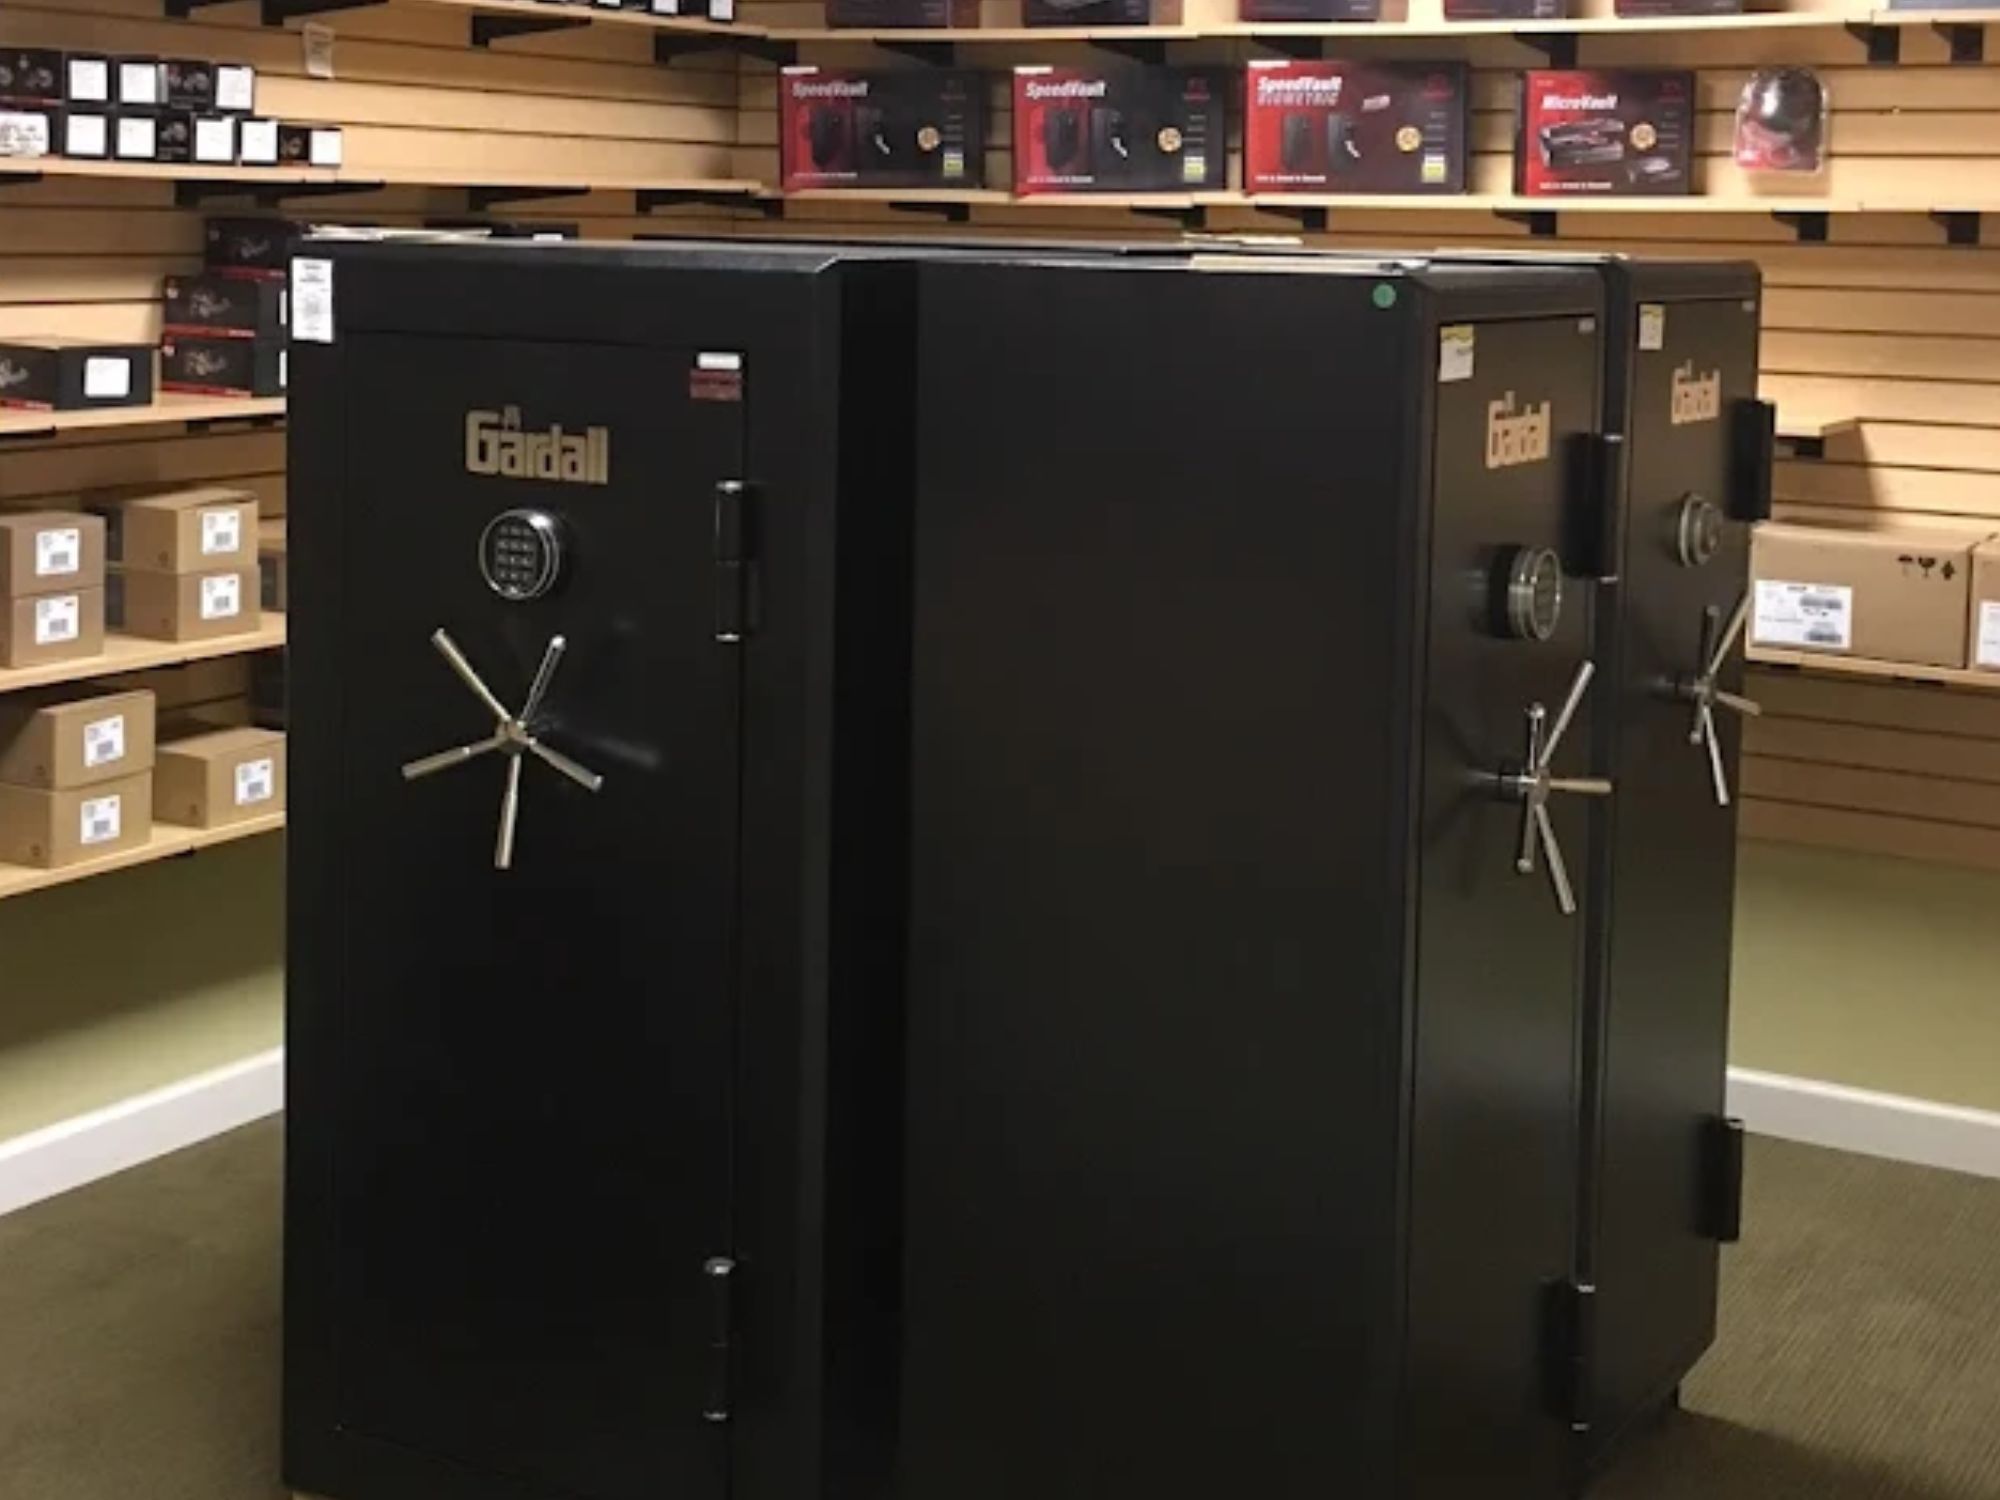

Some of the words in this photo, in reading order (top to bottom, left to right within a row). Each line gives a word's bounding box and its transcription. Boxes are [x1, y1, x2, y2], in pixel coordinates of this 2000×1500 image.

[1026, 80, 1105, 99] SpeedVault
[1257, 75, 1342, 93] SpeedVault
[1541, 94, 1618, 111] MicroVault
[465, 405, 608, 485] Gardall
